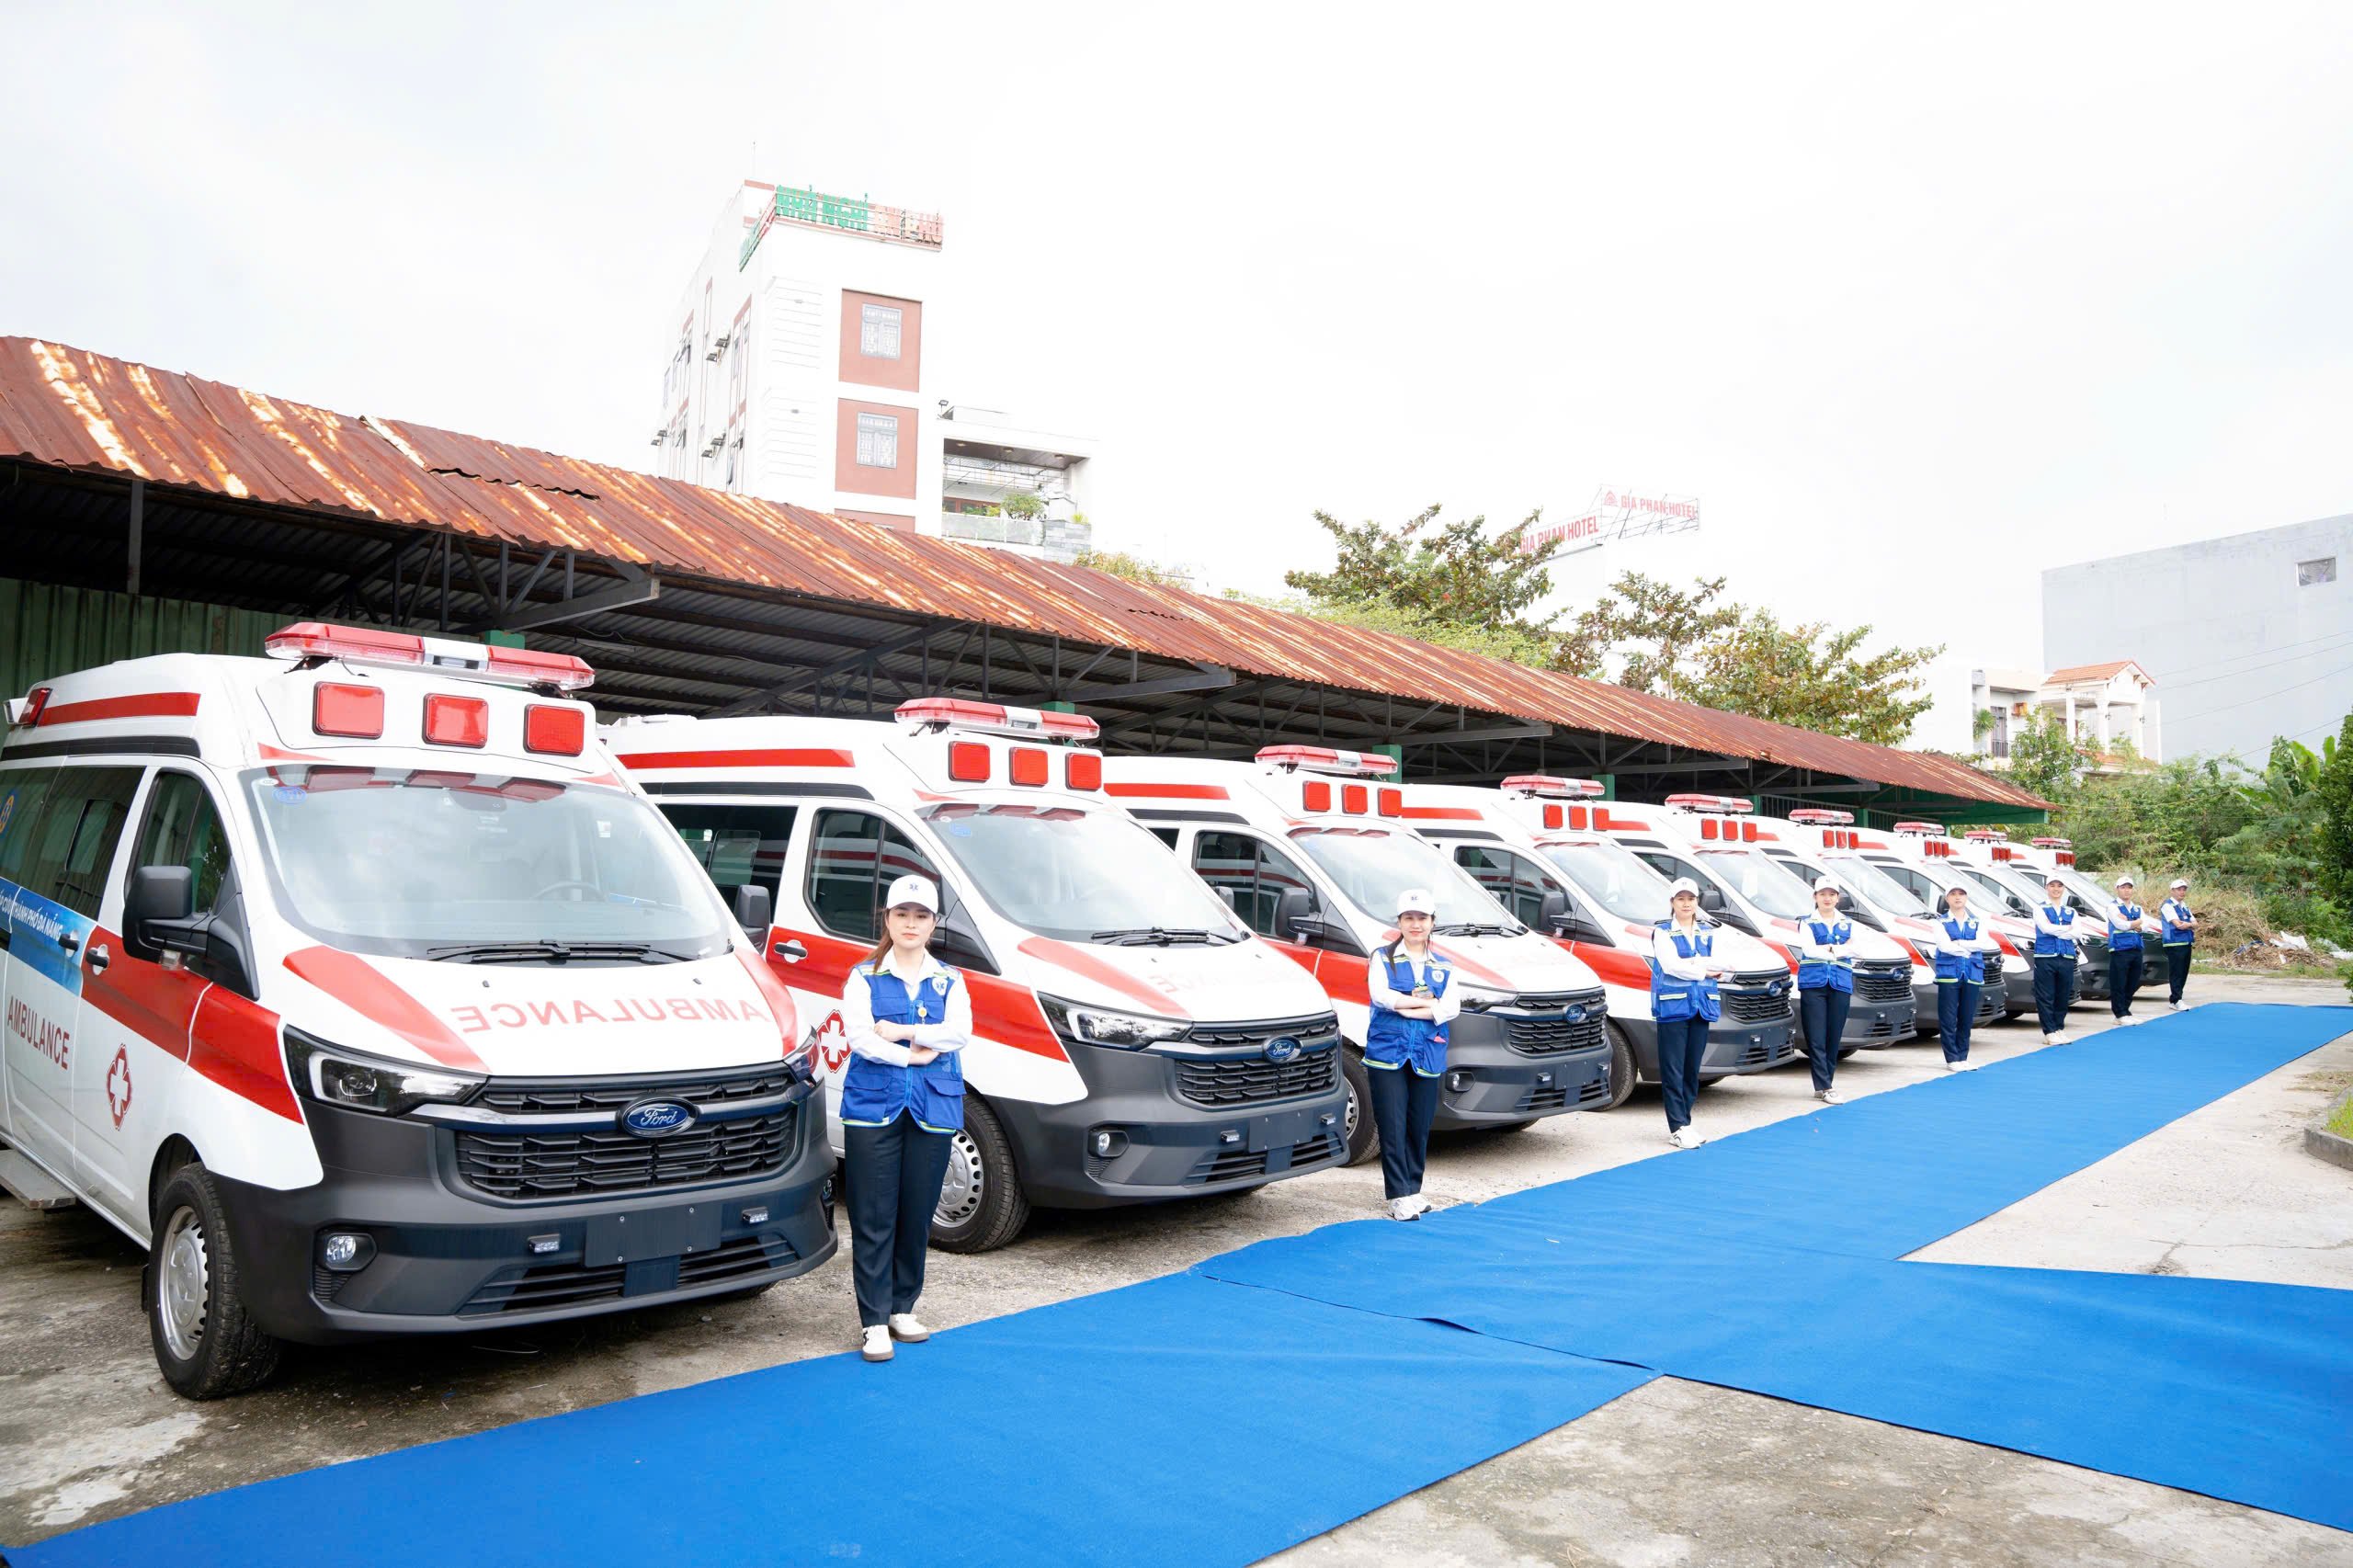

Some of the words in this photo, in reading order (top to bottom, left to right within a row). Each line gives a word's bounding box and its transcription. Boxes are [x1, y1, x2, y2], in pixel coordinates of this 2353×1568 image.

[1620, 494, 1637, 509] GIA
[1640, 498, 1666, 515] PHAN
[1668, 502, 1698, 519] HOTEL
[1567, 515, 1599, 540] HOTEL
[7, 995, 70, 1070] AMBULANCE
[1273, 1042, 1291, 1056] Ford
[641, 1108, 678, 1127] Ford
